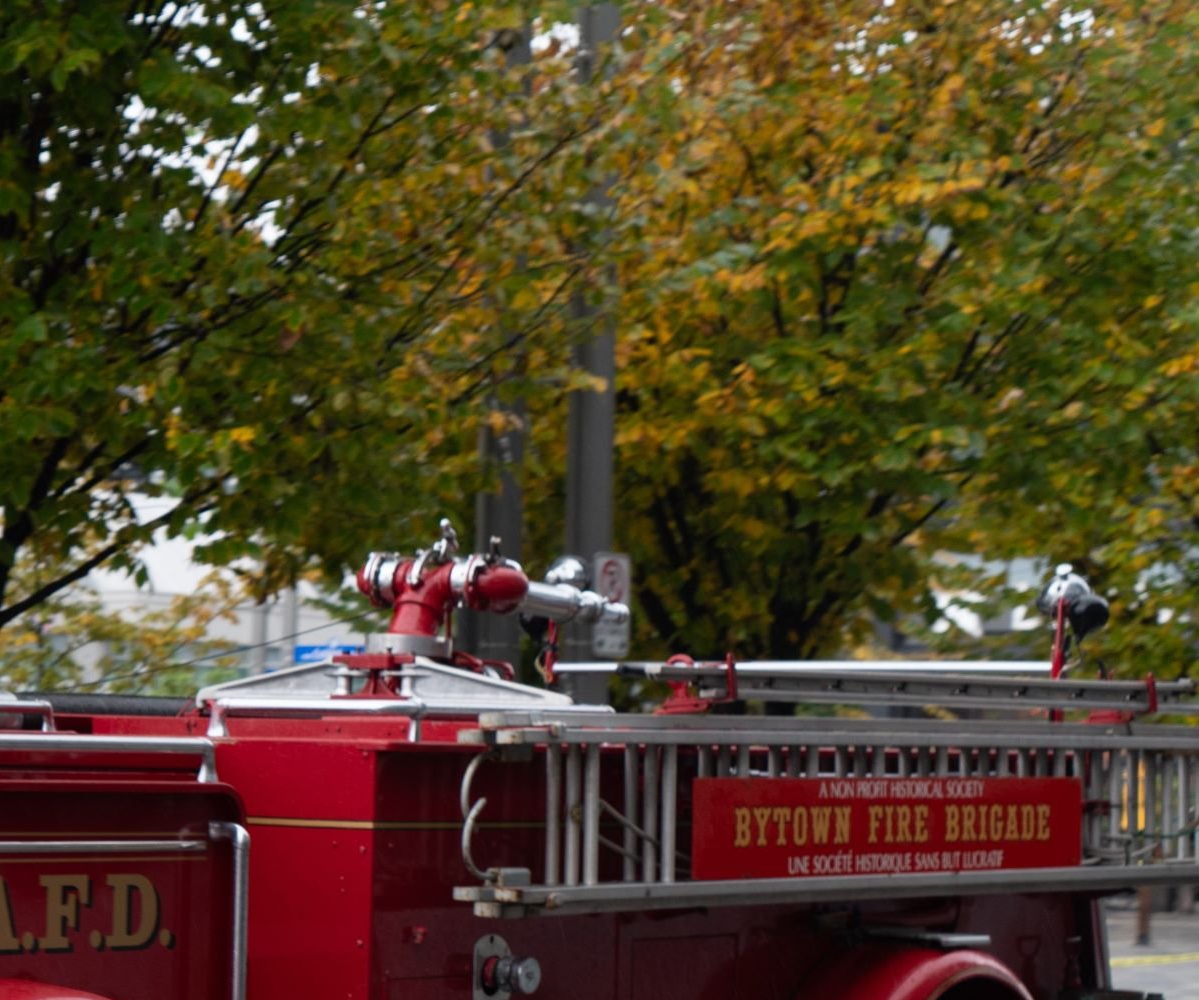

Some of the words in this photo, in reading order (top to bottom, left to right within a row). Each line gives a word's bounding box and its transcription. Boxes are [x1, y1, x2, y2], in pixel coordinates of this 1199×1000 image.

[819, 780, 828, 796] A
[830, 780, 853, 797] NON
[857, 780, 888, 797] PROFIT
[891, 780, 943, 797] HISTORICAL
[946, 780, 985, 797] SOCIETY
[735, 806, 851, 846] BYTOWN
[868, 805, 929, 843] FIRE
[944, 804, 1051, 841] BRIGADE
[788, 856, 810, 874] UNE
[813, 851, 853, 873] SOCIÉTÉ
[856, 854, 911, 873] HISTORIQUE
[915, 853, 940, 871] SANS
[942, 852, 961, 870] BUT
[963, 850, 1004, 869] LUCRATIF
